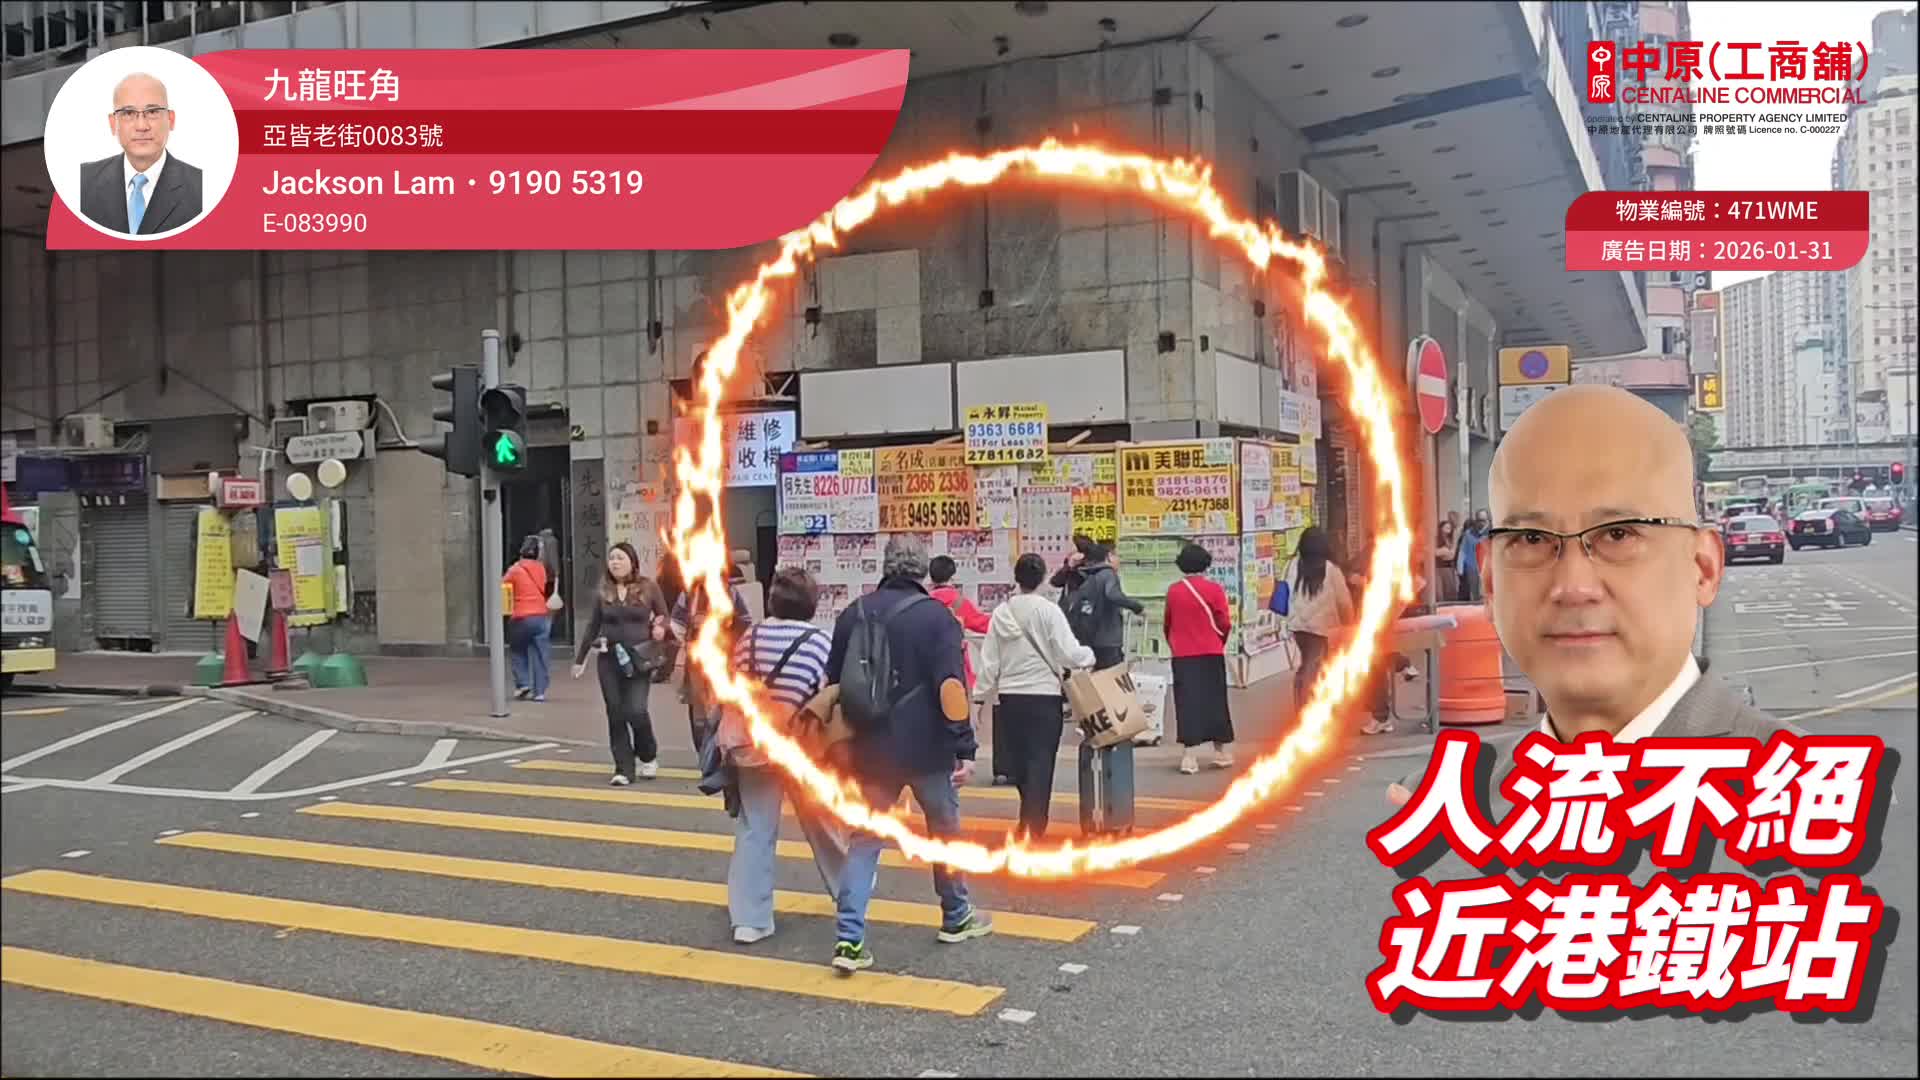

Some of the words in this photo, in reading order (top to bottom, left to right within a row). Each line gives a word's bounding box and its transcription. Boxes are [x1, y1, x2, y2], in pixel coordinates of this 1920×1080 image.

[968, 423, 1004, 438] 9363
[1008, 421, 1042, 436] 6681
[813, 475, 840, 497] 8226
[842, 475, 870, 495] 0773
[906, 472, 936, 494] 2366
[908, 502, 938, 528] 9495
[940, 501, 971, 527] 5689
[1171, 498, 1230, 512] 2311-7368
